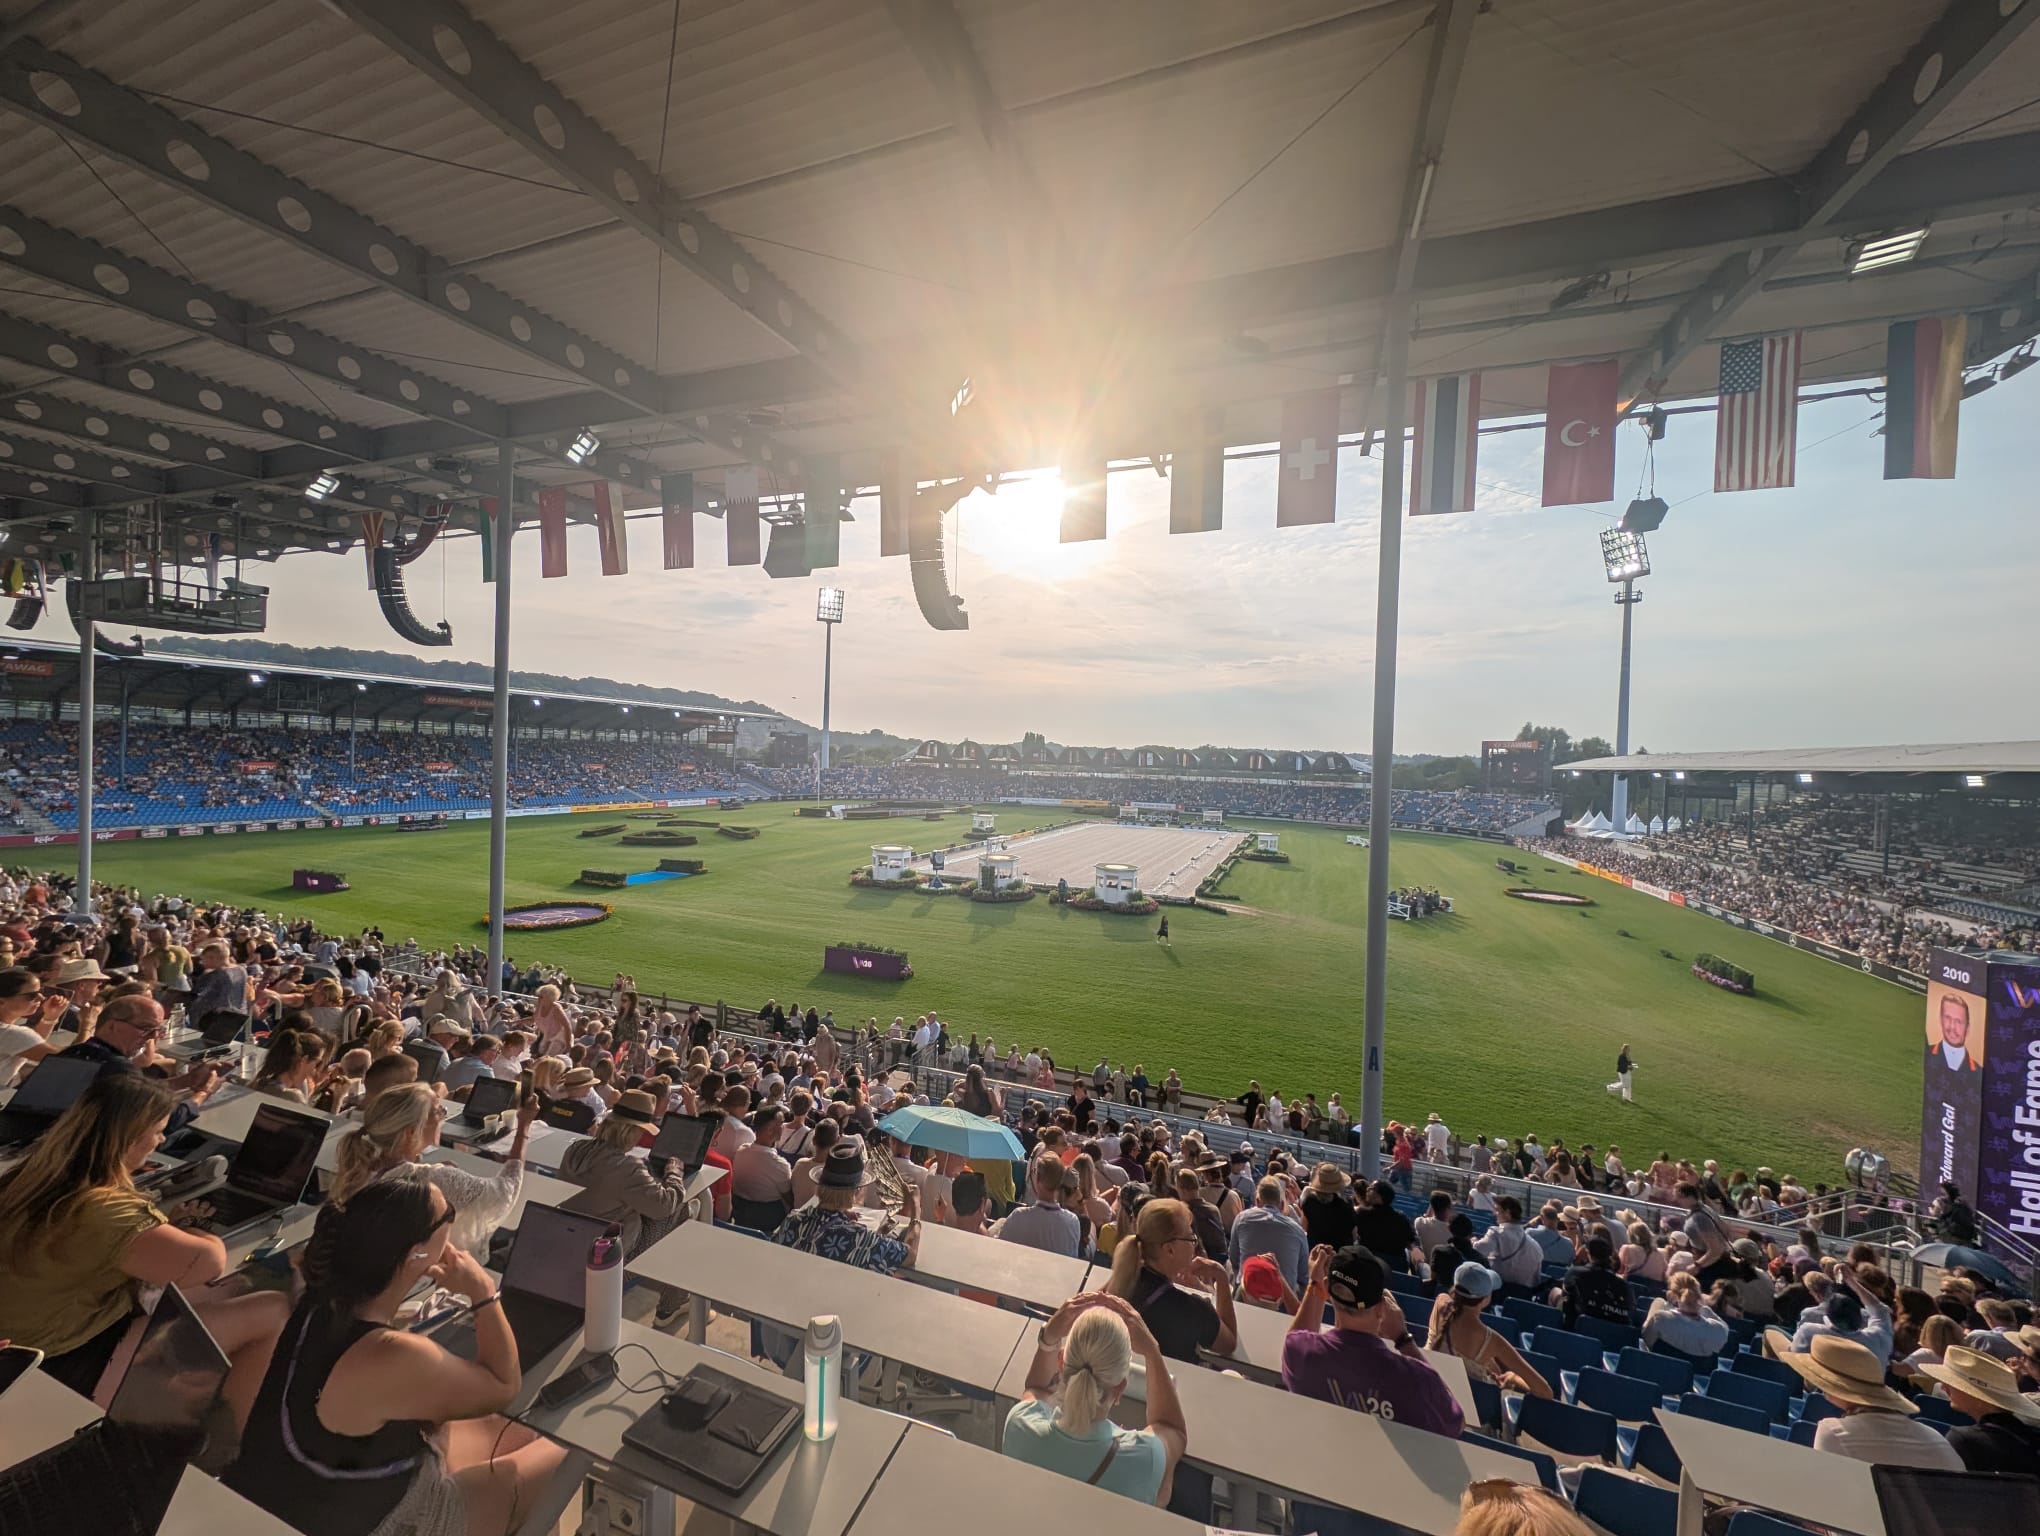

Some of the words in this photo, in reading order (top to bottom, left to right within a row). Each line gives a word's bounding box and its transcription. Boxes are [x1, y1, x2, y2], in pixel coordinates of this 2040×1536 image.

[1942, 965, 1970, 984] 2010
[1368, 1046, 1379, 1072] A
[2014, 1040, 2040, 1126] Fame
[1941, 1102, 1956, 1131] Gal
[2012, 1128, 2040, 1167] of
[2009, 1169, 2040, 1235] Hall
[1366, 1396, 1395, 1420] 26
